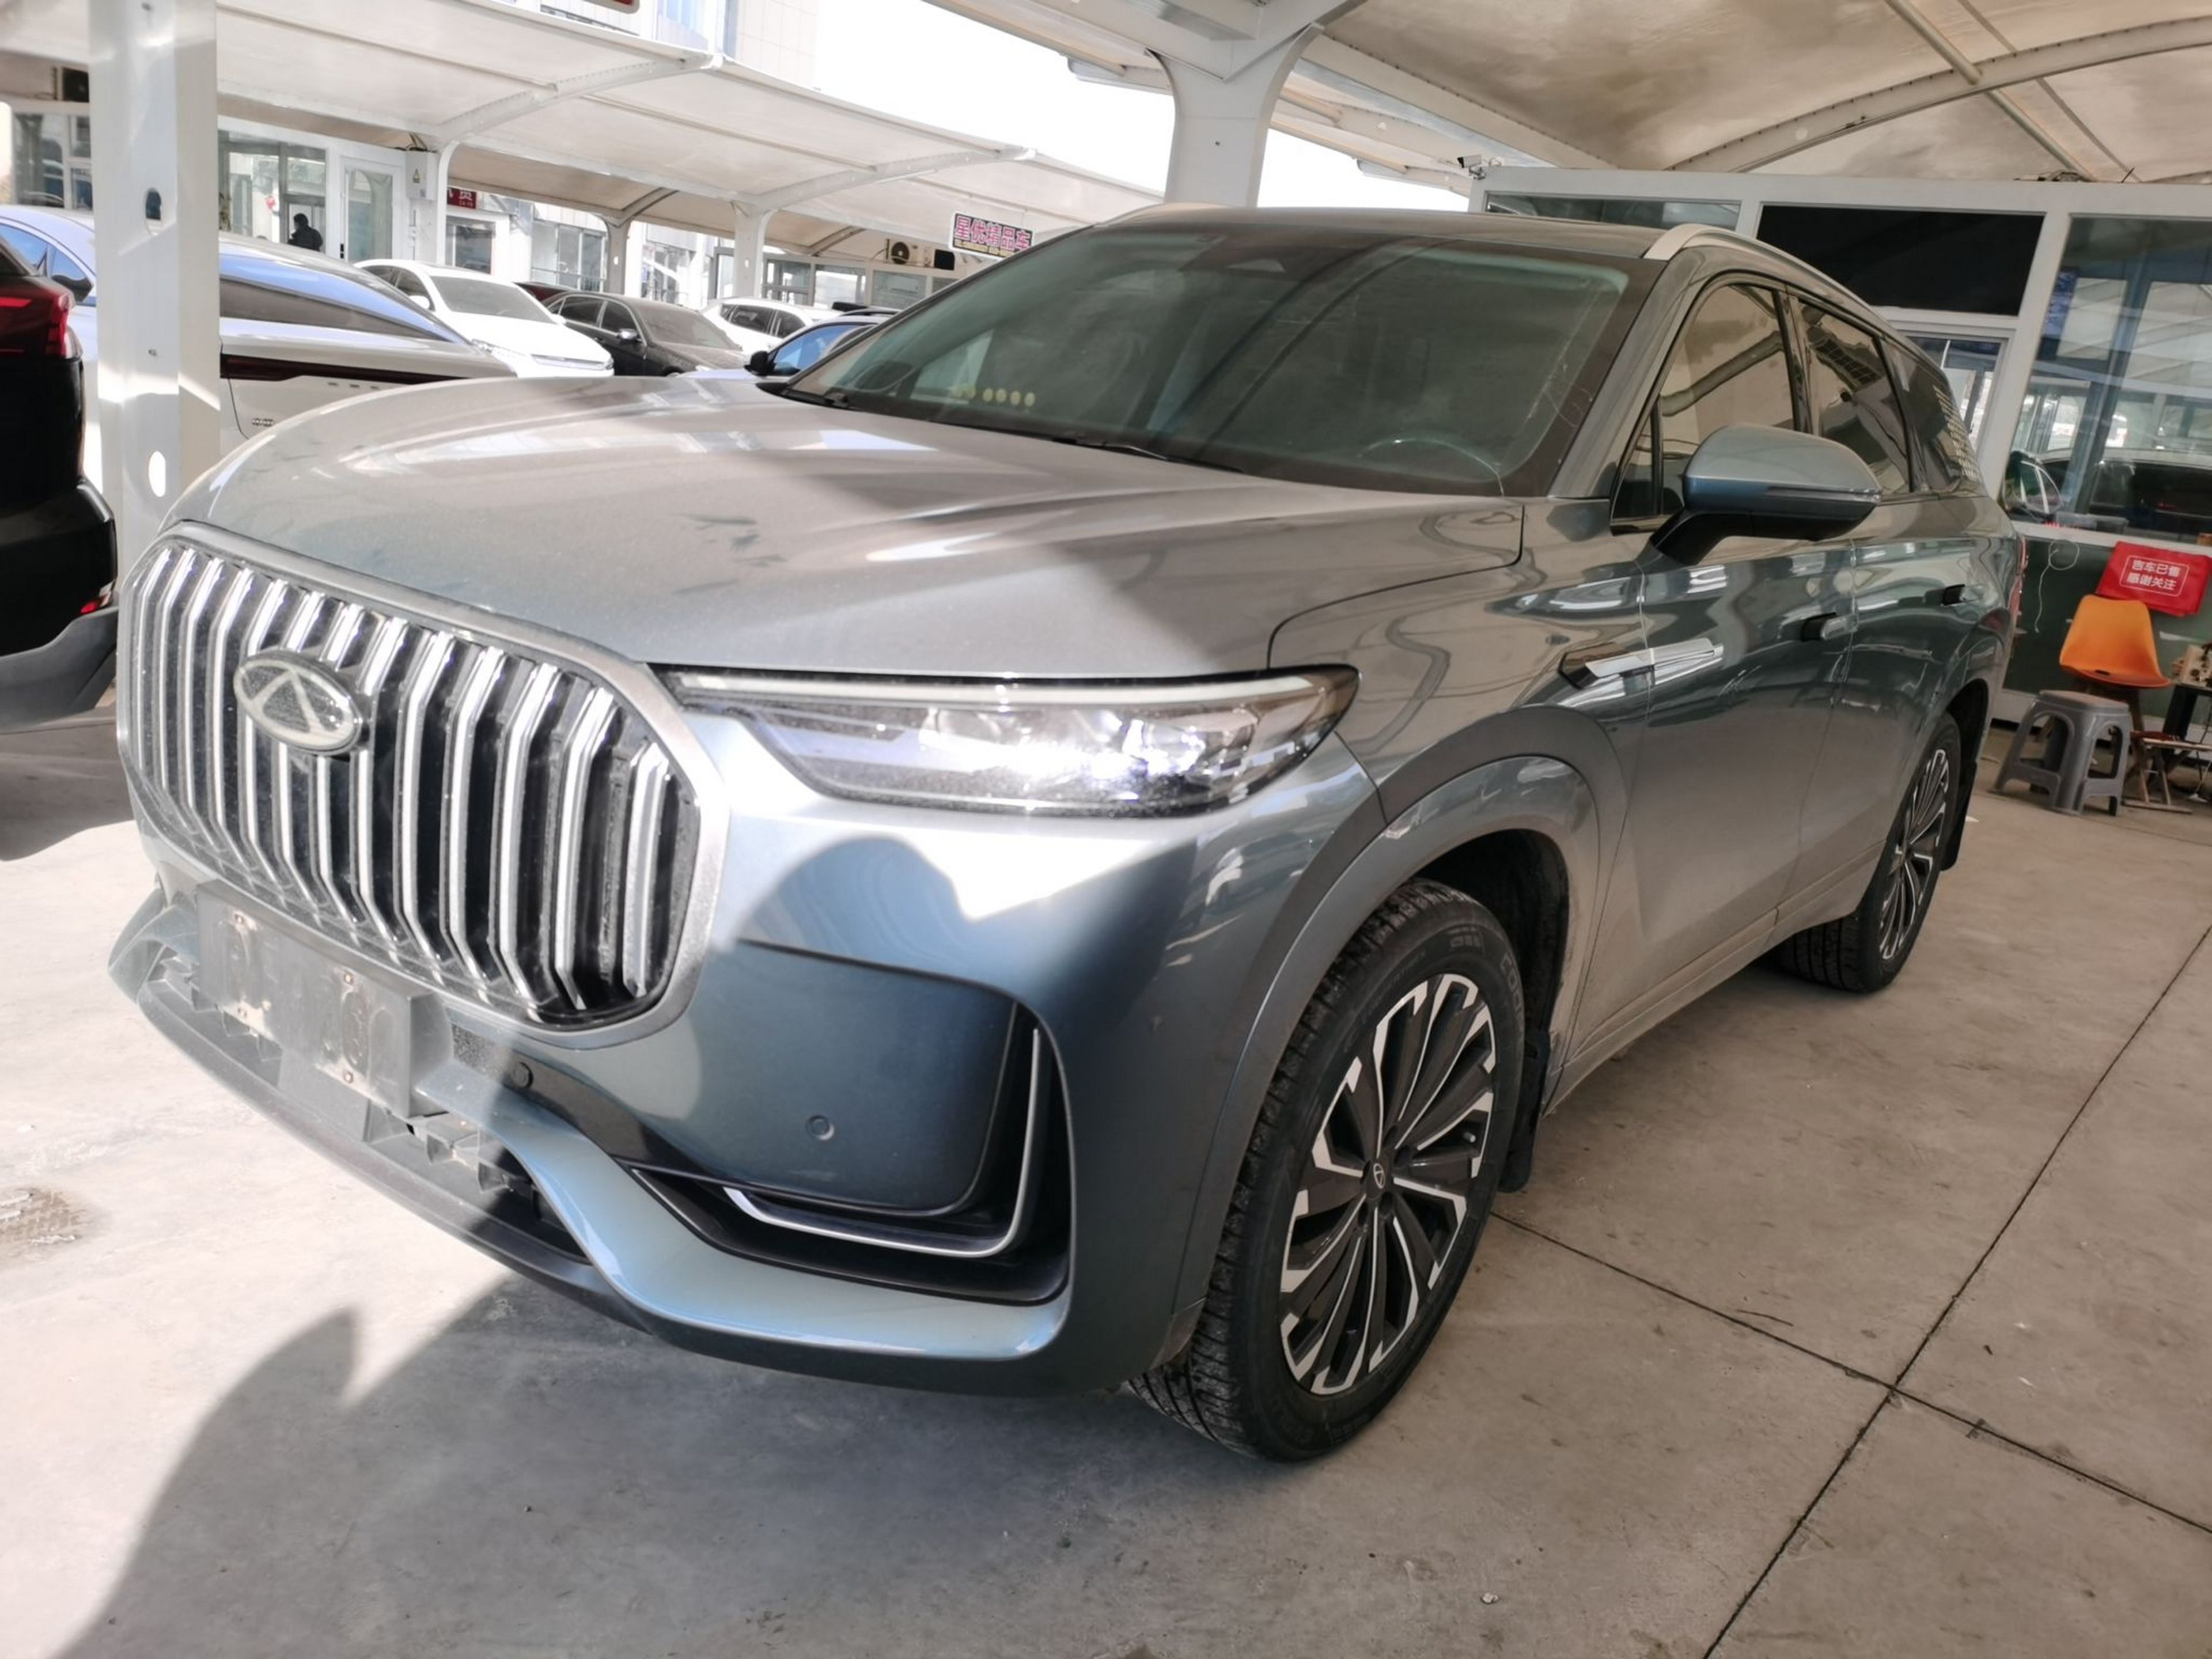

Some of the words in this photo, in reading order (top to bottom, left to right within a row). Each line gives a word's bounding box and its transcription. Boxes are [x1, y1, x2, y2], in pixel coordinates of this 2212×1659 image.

[955, 215, 1031, 251] 星优精品车
[2126, 572, 2177, 591] 感谢关注
